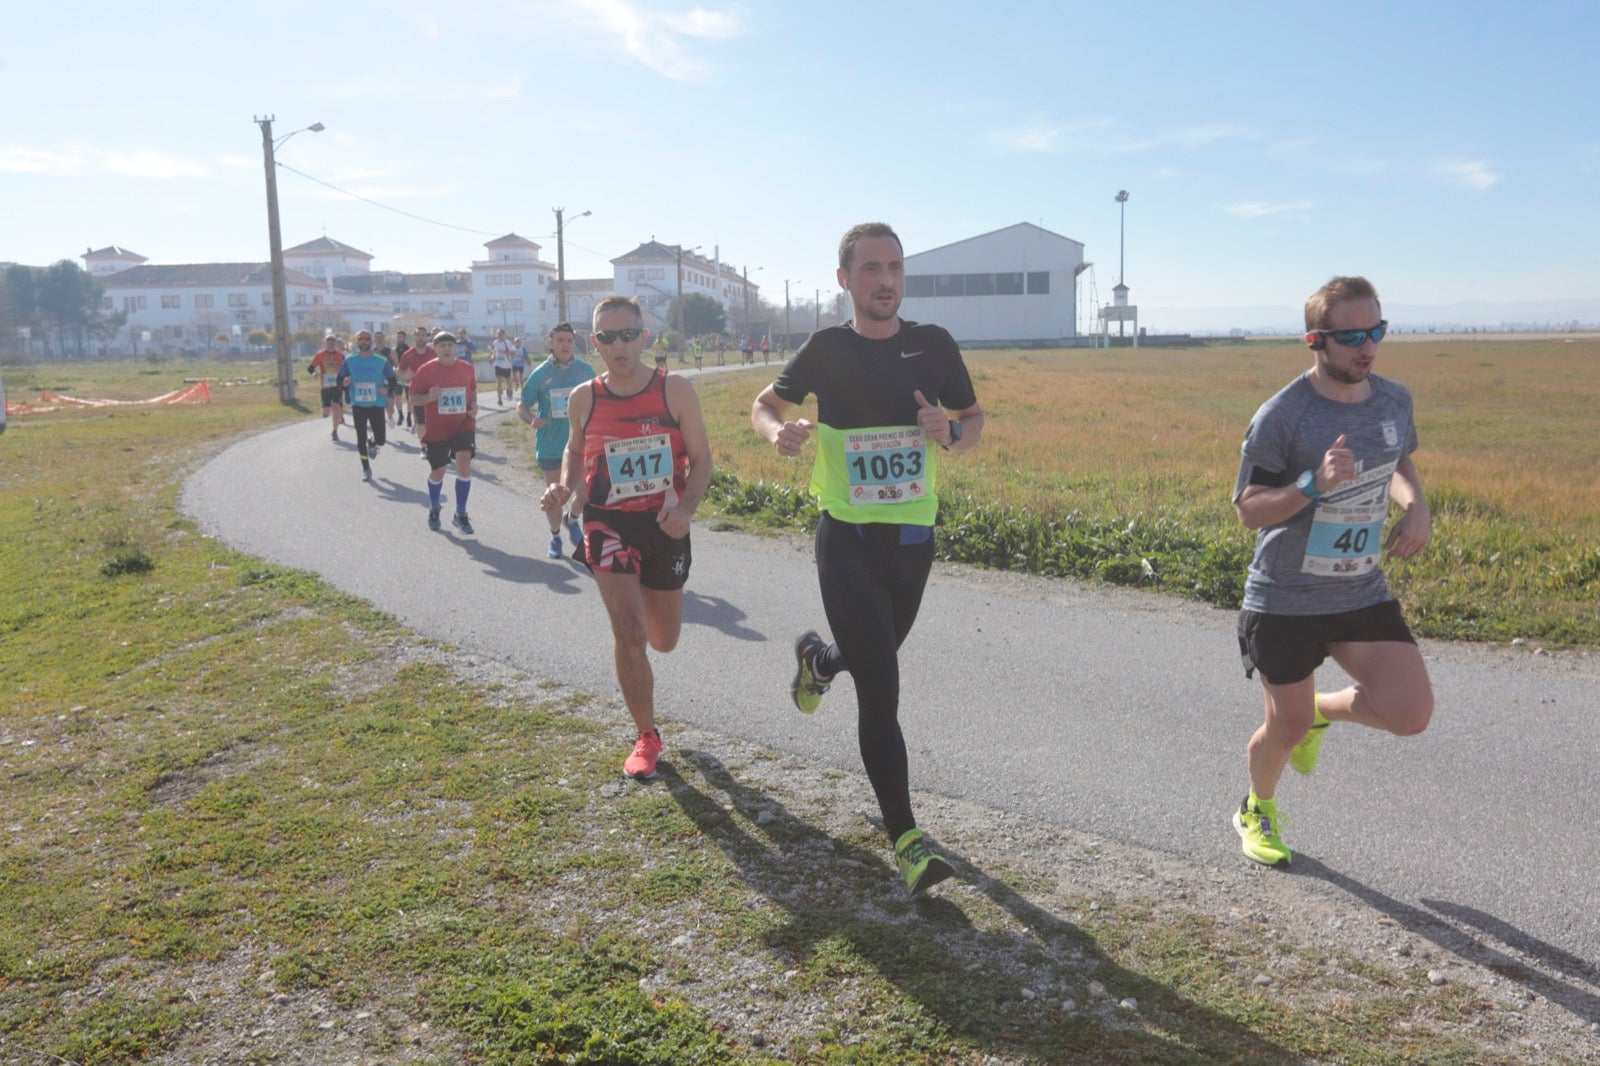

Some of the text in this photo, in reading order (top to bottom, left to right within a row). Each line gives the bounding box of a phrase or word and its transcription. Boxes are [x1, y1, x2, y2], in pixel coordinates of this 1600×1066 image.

[442, 395, 462, 406] 218
[879, 432, 897, 440] PREMIO
[898, 431, 905, 439] DE
[620, 453, 662, 477] 417
[852, 450, 922, 480] 1063
[1333, 527, 1369, 553] 40
